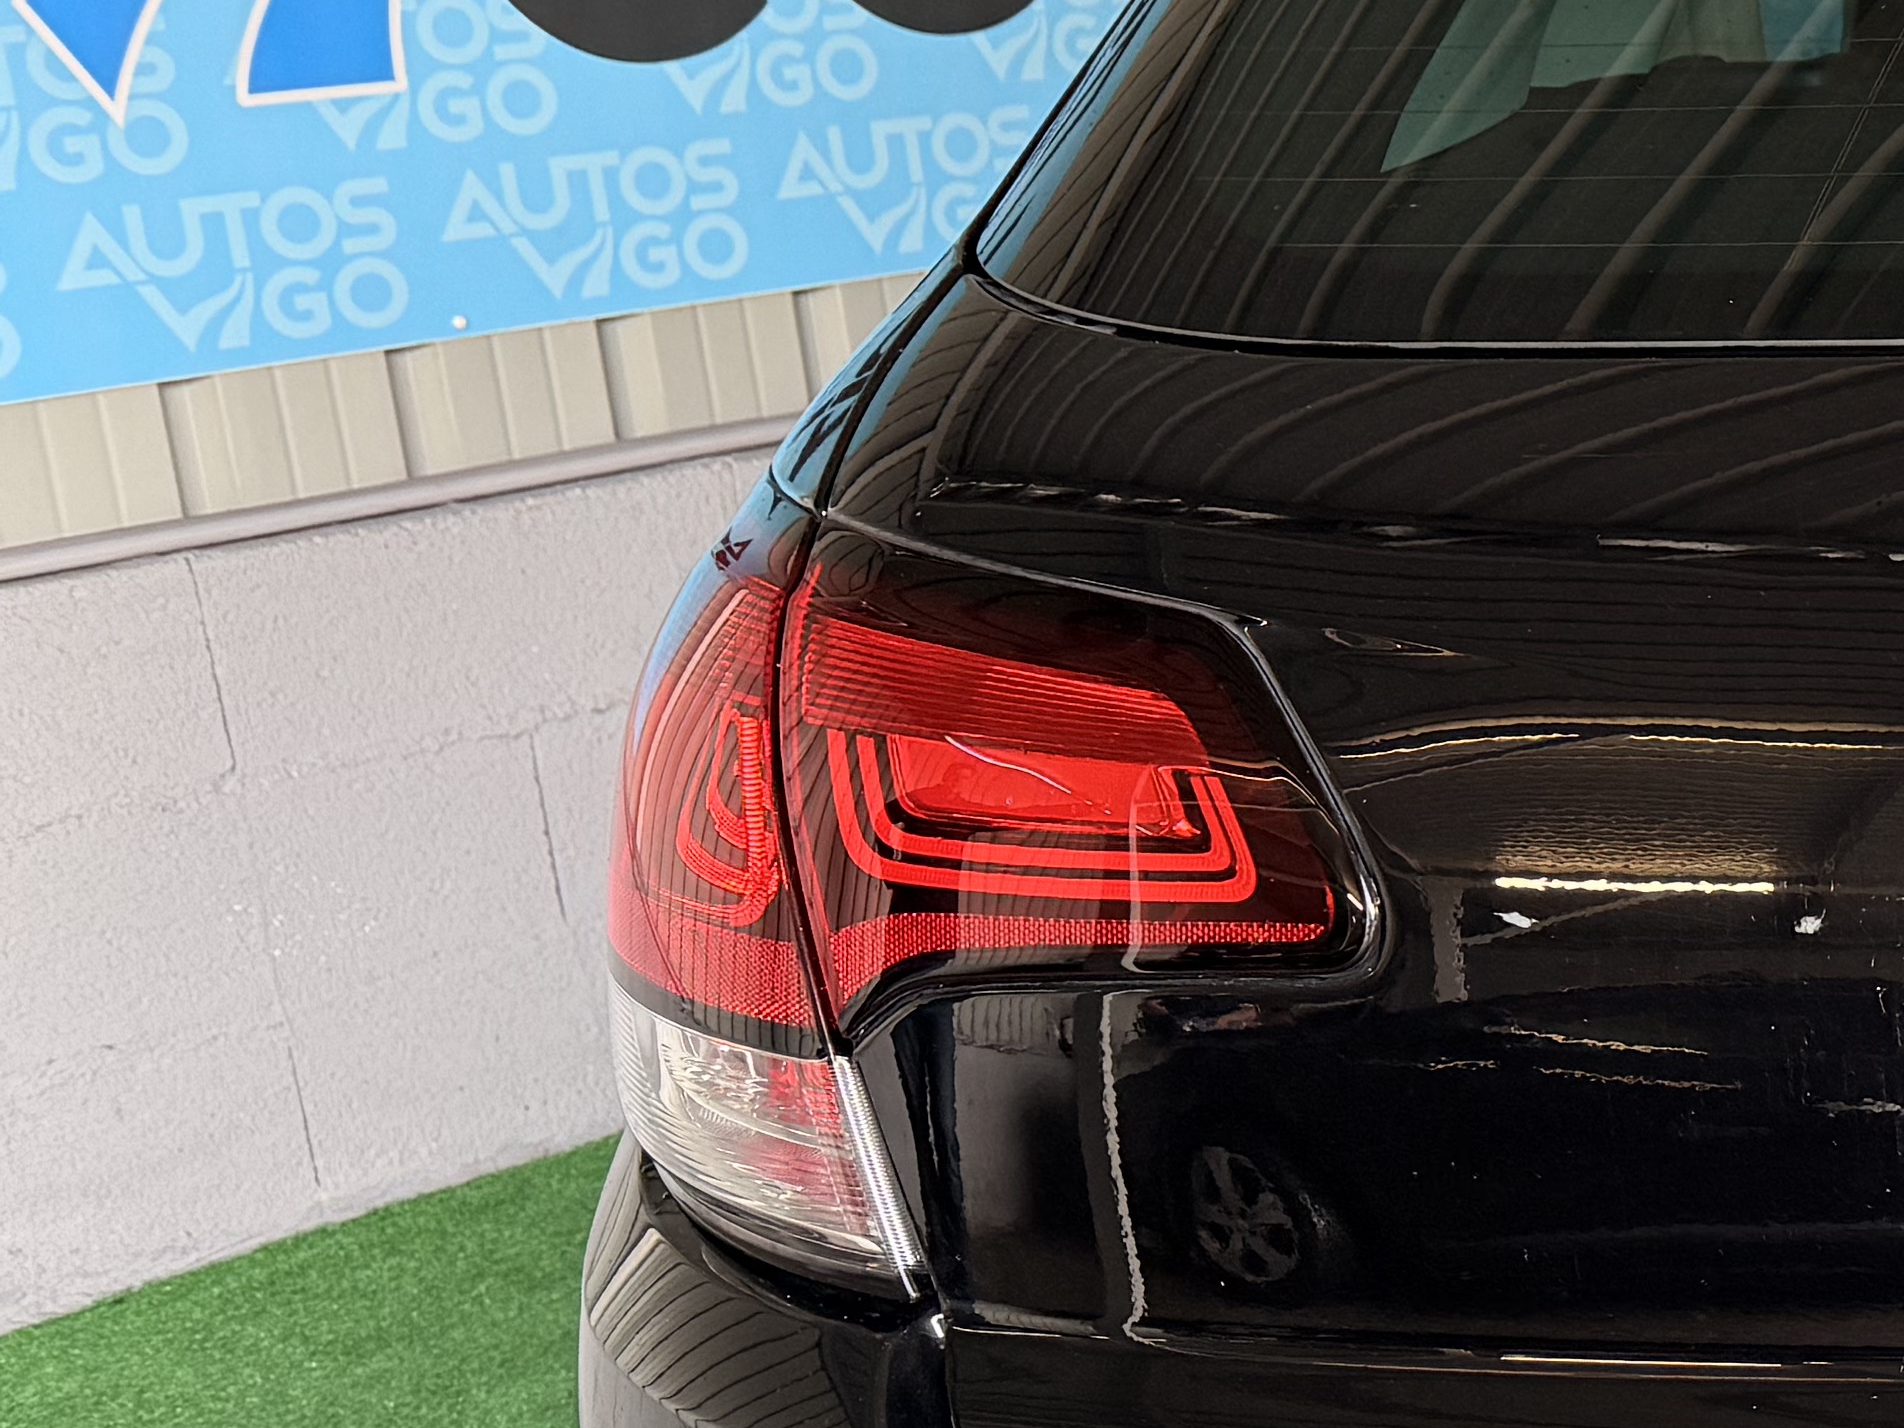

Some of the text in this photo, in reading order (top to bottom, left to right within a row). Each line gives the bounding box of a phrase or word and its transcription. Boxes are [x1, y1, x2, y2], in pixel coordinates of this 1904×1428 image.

[57, 175, 398, 292] AUTOS
[441, 138, 739, 243] AUTOS
[135, 256, 409, 354] VIGO
[510, 212, 750, 300] VIGO
